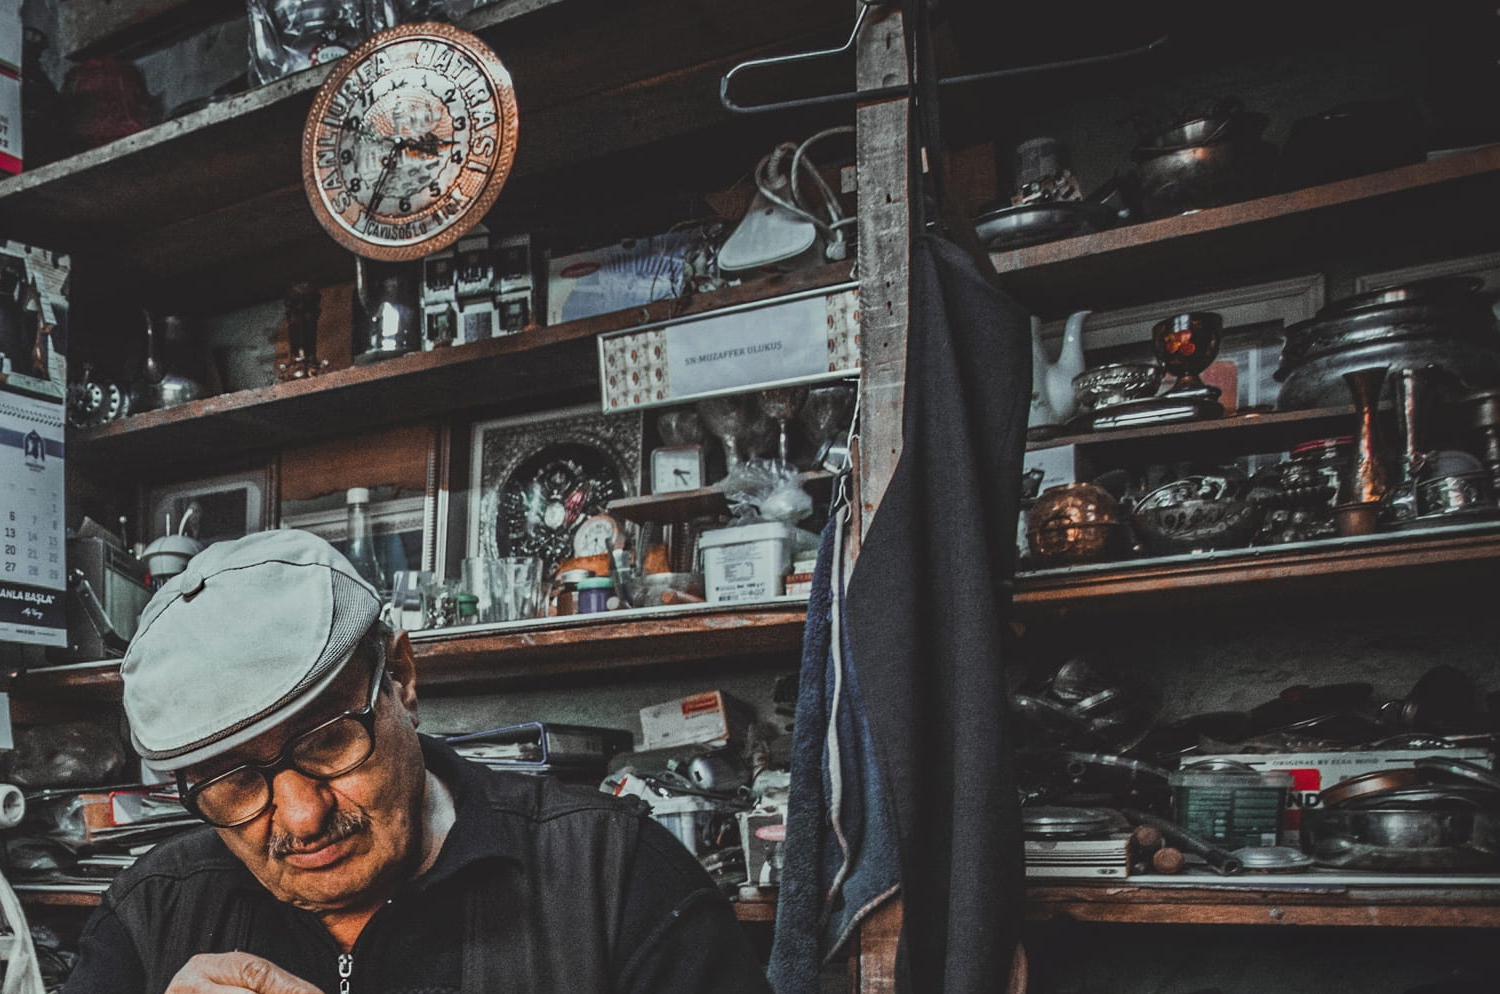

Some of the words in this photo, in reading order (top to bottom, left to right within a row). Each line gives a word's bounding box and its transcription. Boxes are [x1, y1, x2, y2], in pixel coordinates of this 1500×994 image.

[444, 88, 457, 104] 2
[452, 116, 466, 131] 3
[340, 149, 353, 165] 9
[451, 150, 464, 165] 4
[350, 178, 361, 193] 8
[428, 181, 442, 197] 5
[399, 198, 412, 213] 6
[9, 511, 15, 521] 6
[5, 528, 15, 538] 13
[5, 545, 16, 555] 20
[5, 562, 16, 572] 27
